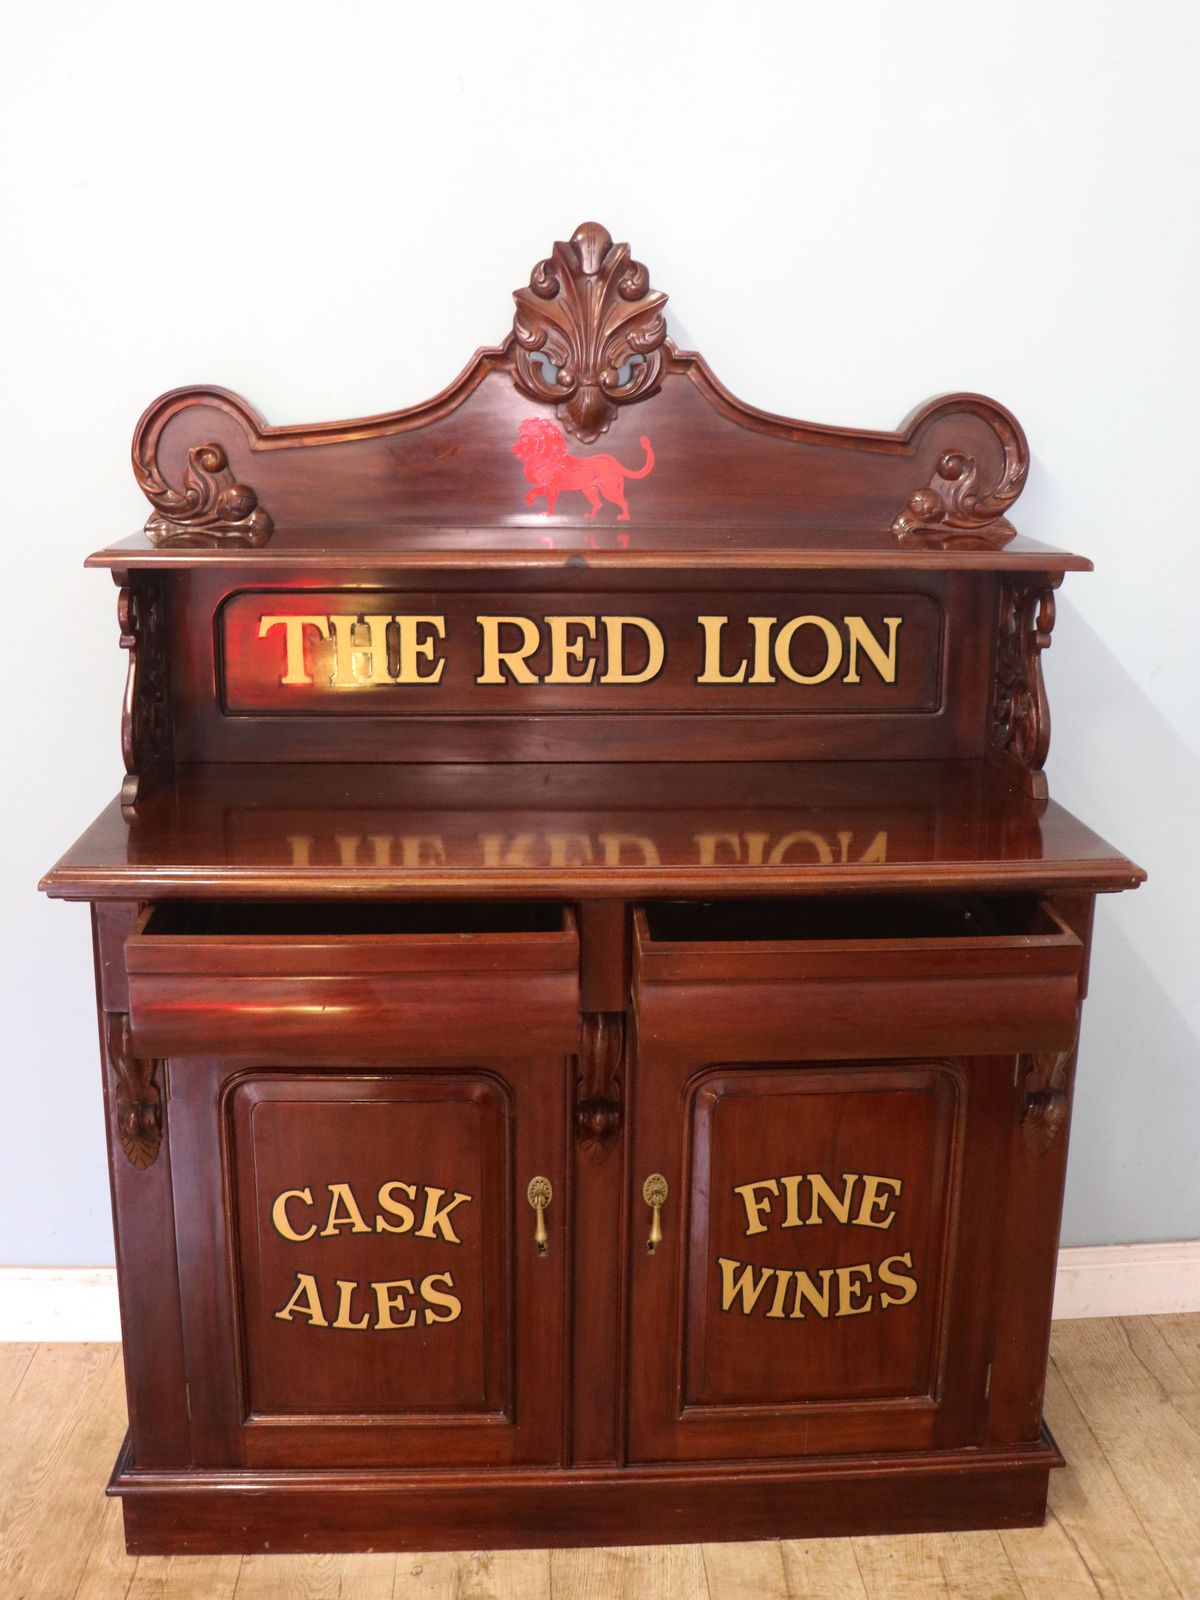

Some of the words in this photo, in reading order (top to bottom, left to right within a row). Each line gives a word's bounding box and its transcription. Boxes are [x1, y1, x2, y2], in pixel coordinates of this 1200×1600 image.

[258, 615, 446, 685] THE
[476, 615, 664, 684] RED
[697, 615, 902, 685] LION
[272, 1181, 471, 1243] CASK
[734, 1174, 902, 1236] FINE
[275, 1272, 462, 1330] ALES
[718, 1252, 918, 1318] WINES
